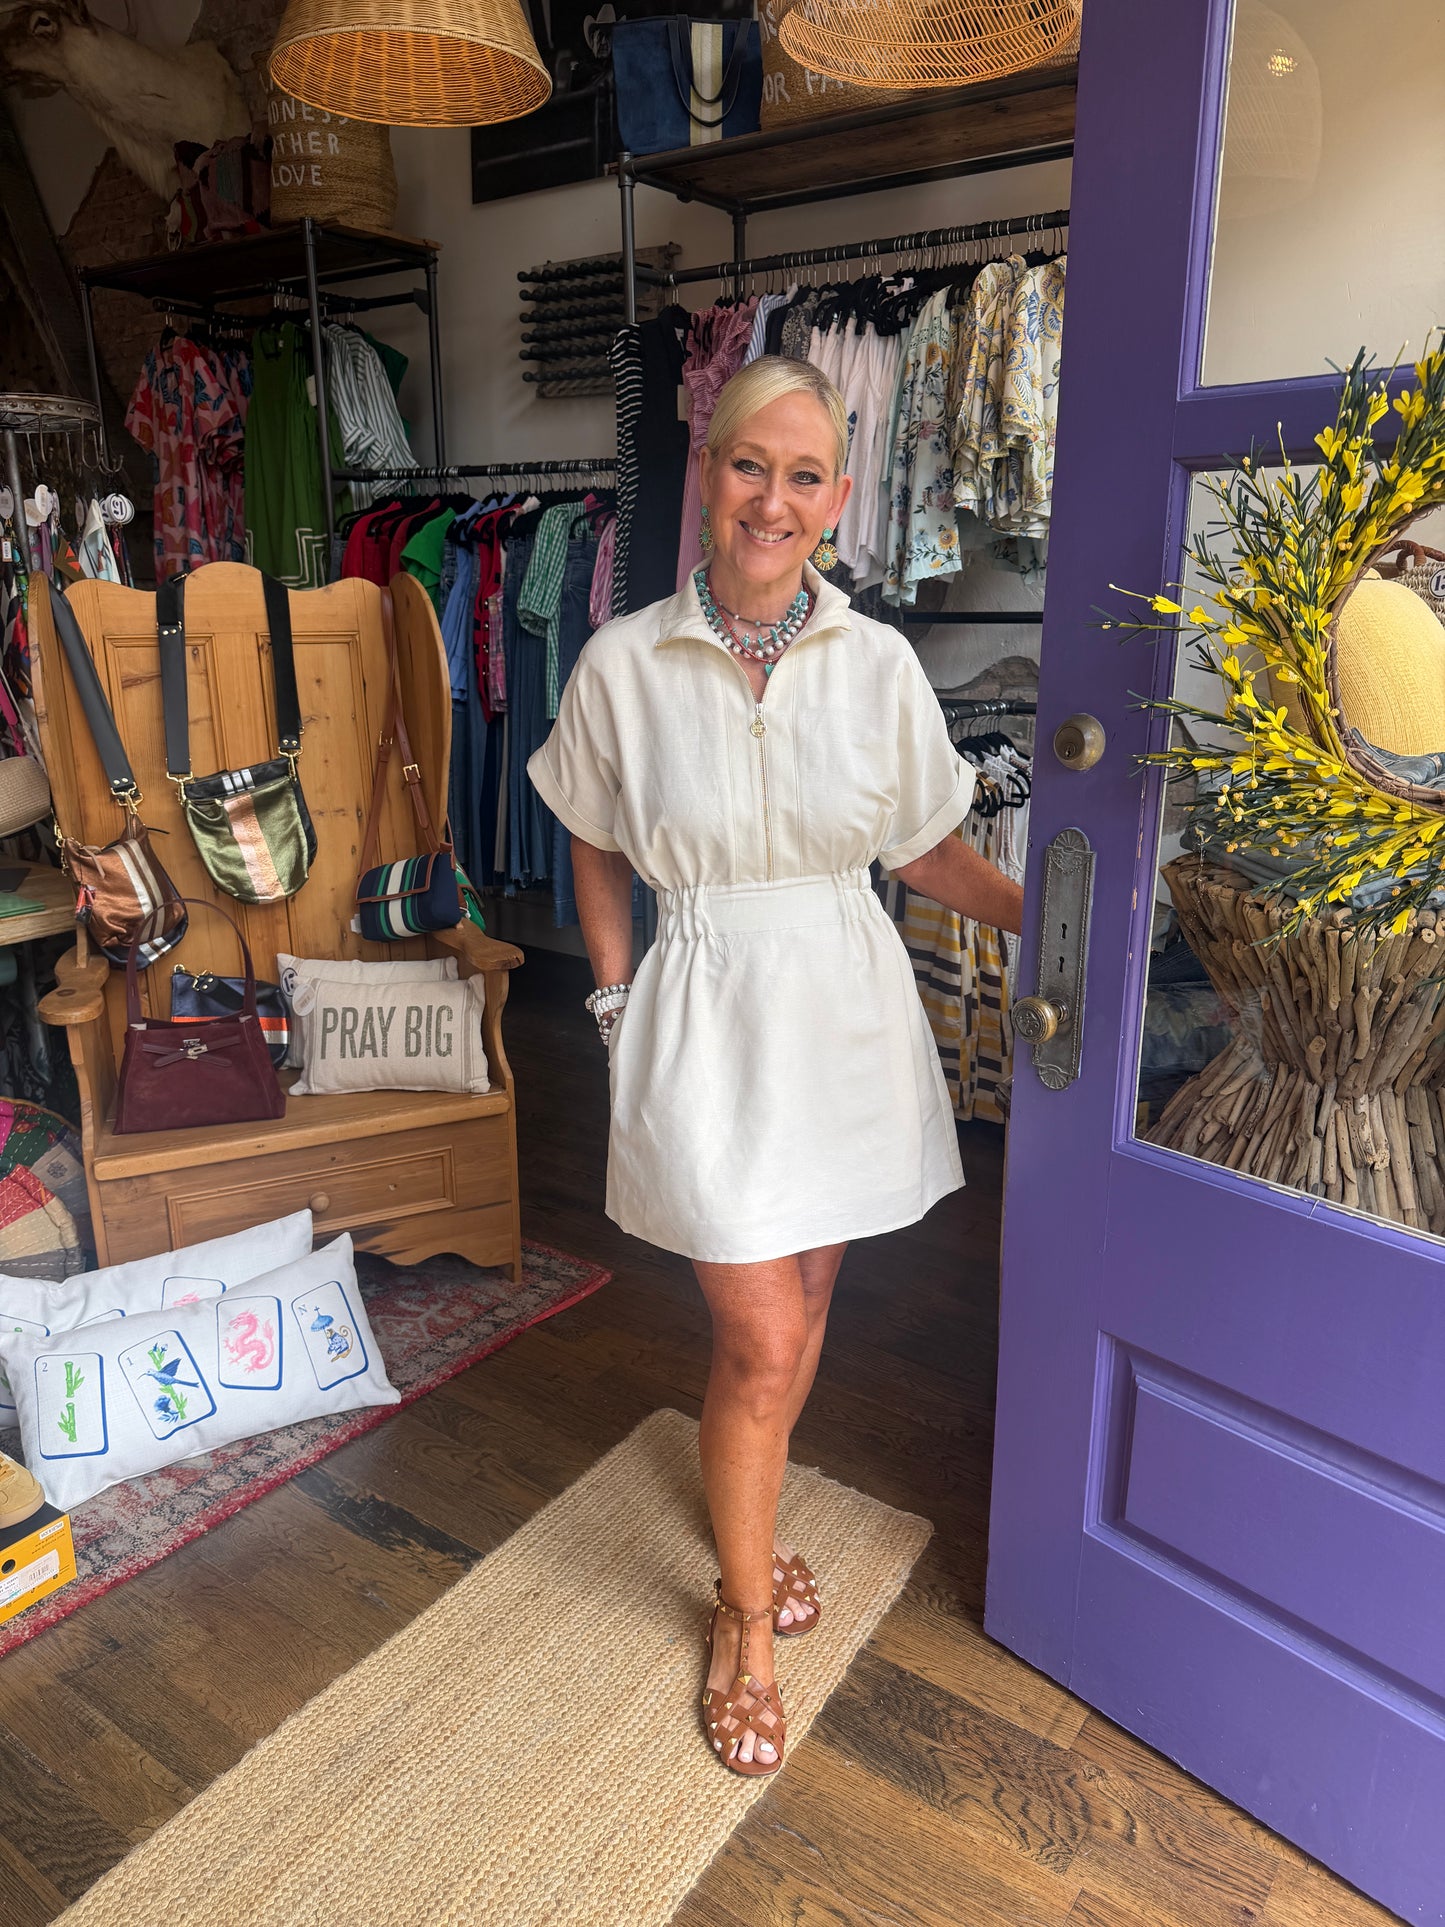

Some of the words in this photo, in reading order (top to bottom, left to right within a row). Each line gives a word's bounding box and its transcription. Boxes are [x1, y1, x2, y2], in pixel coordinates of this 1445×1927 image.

[271, 164, 322, 187] LOVE
[320, 1006, 397, 1060] PRAY
[404, 1004, 454, 1058] BIG
[41, 1362, 49, 1372] 2
